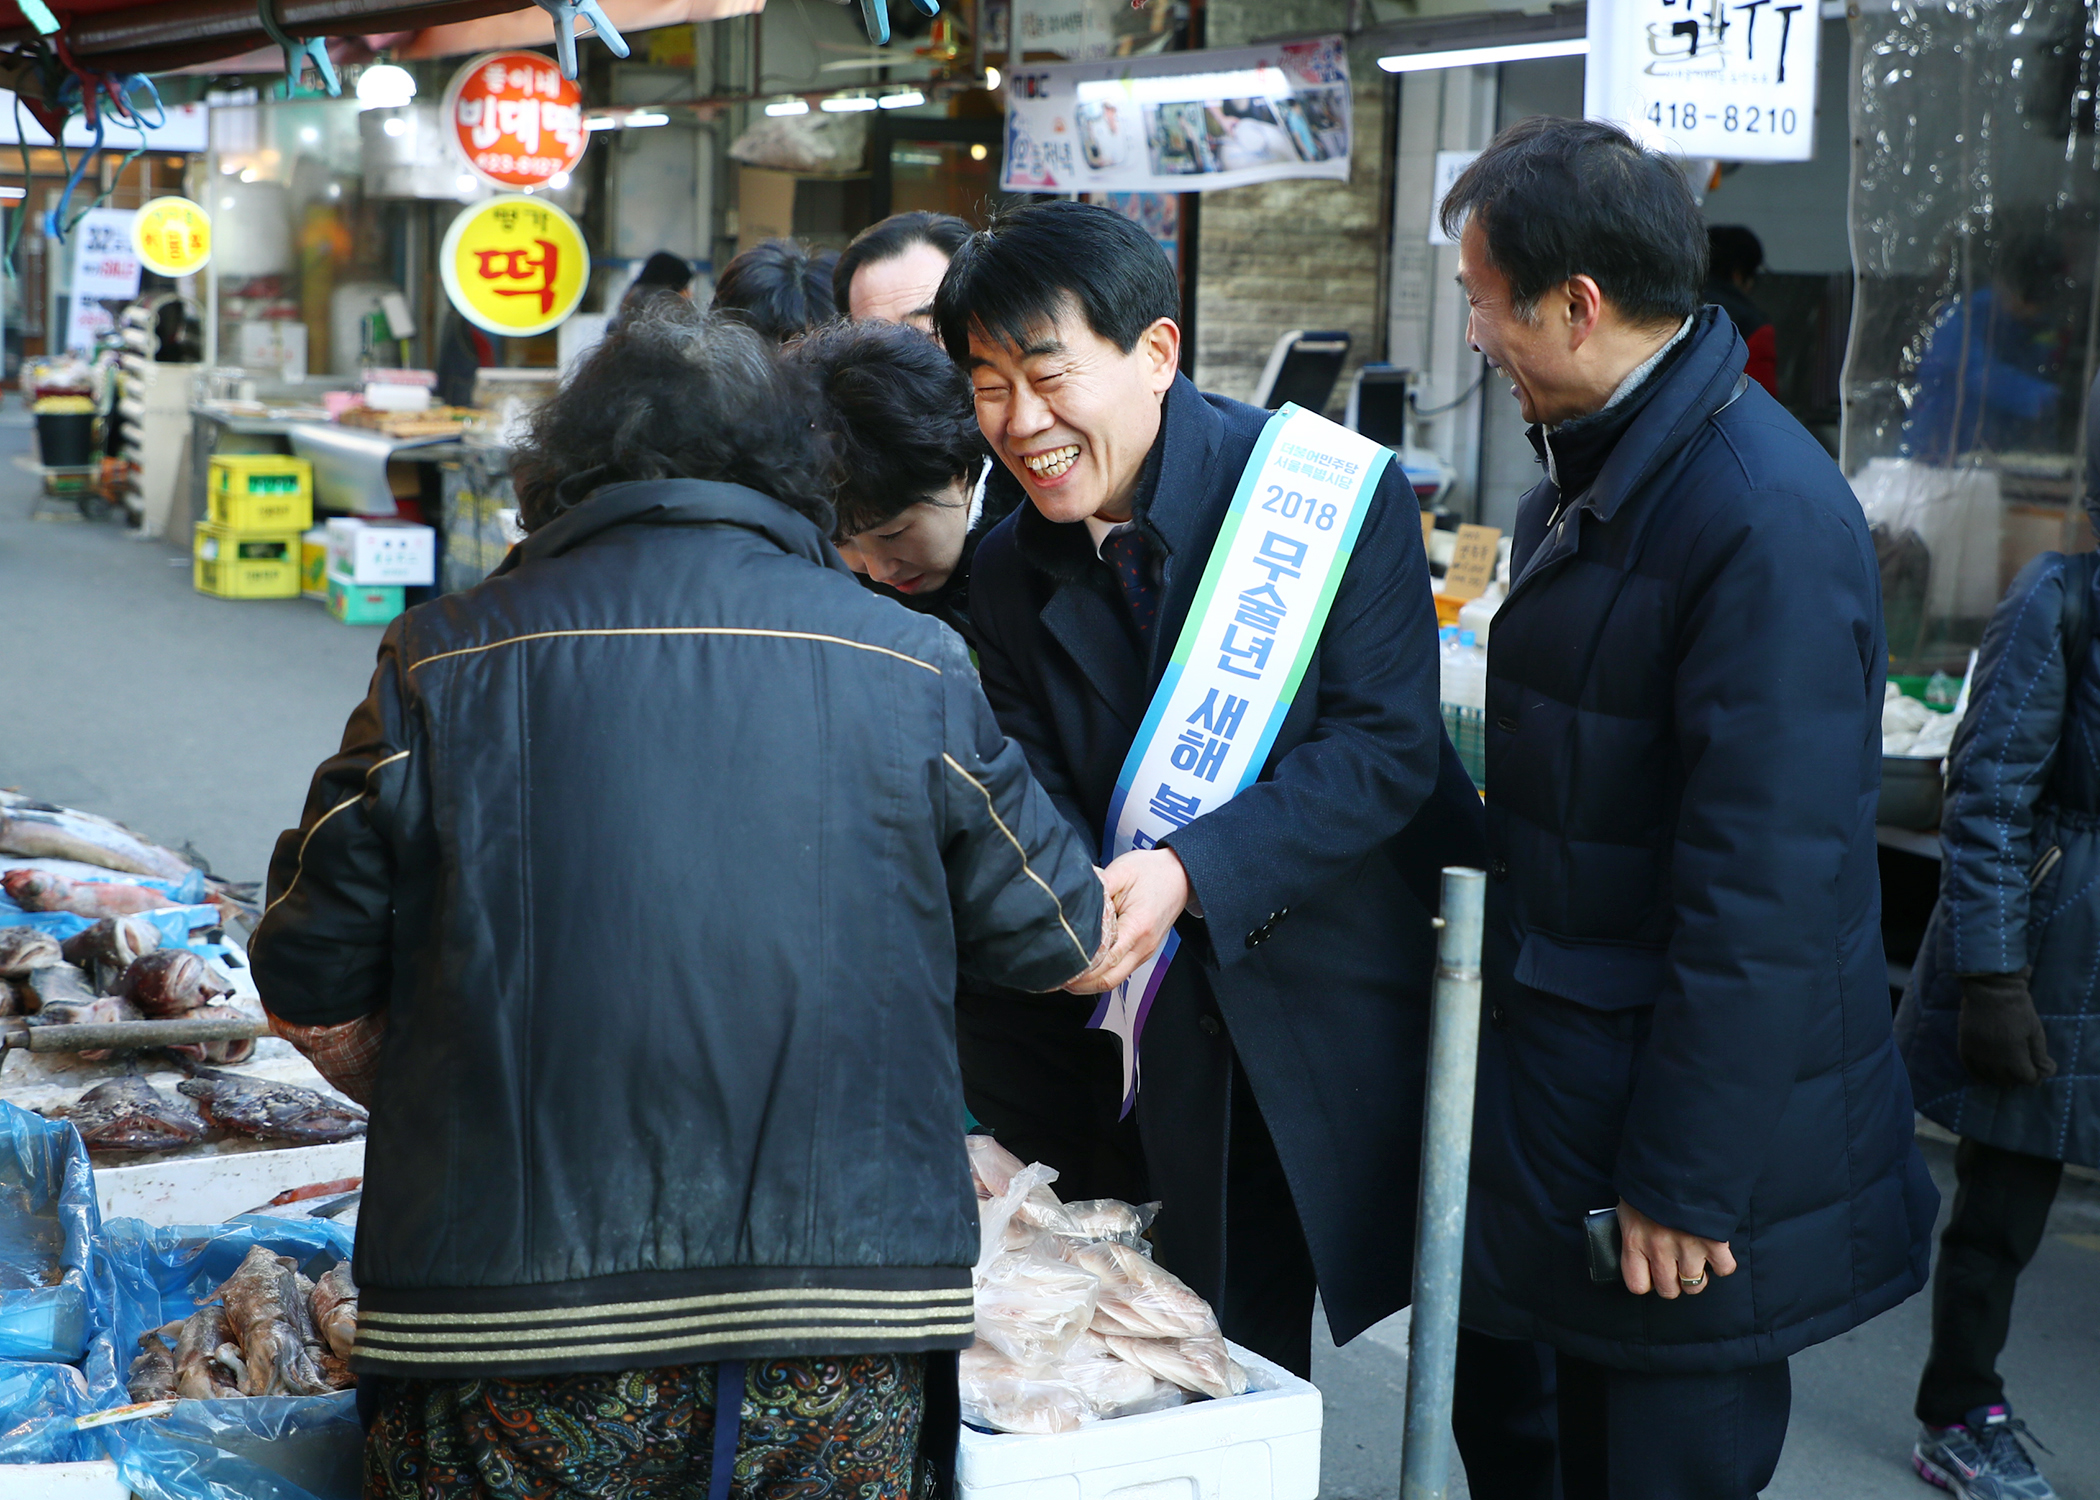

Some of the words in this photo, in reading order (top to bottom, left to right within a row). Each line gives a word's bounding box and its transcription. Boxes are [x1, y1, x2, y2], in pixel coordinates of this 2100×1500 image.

[1012, 74, 1050, 99] MBC
[458, 94, 582, 158] 빈대떡
[1647, 101, 1796, 135] 418-8210
[474, 239, 558, 315] 떡
[1273, 455, 1354, 490] 서울특별시당
[1279, 442, 1360, 475] 더불어민주당
[1261, 484, 1338, 531] 2018
[1217, 530, 1309, 681] 무술년
[1170, 687, 1250, 783] 새해
[1149, 782, 1202, 831] 복
